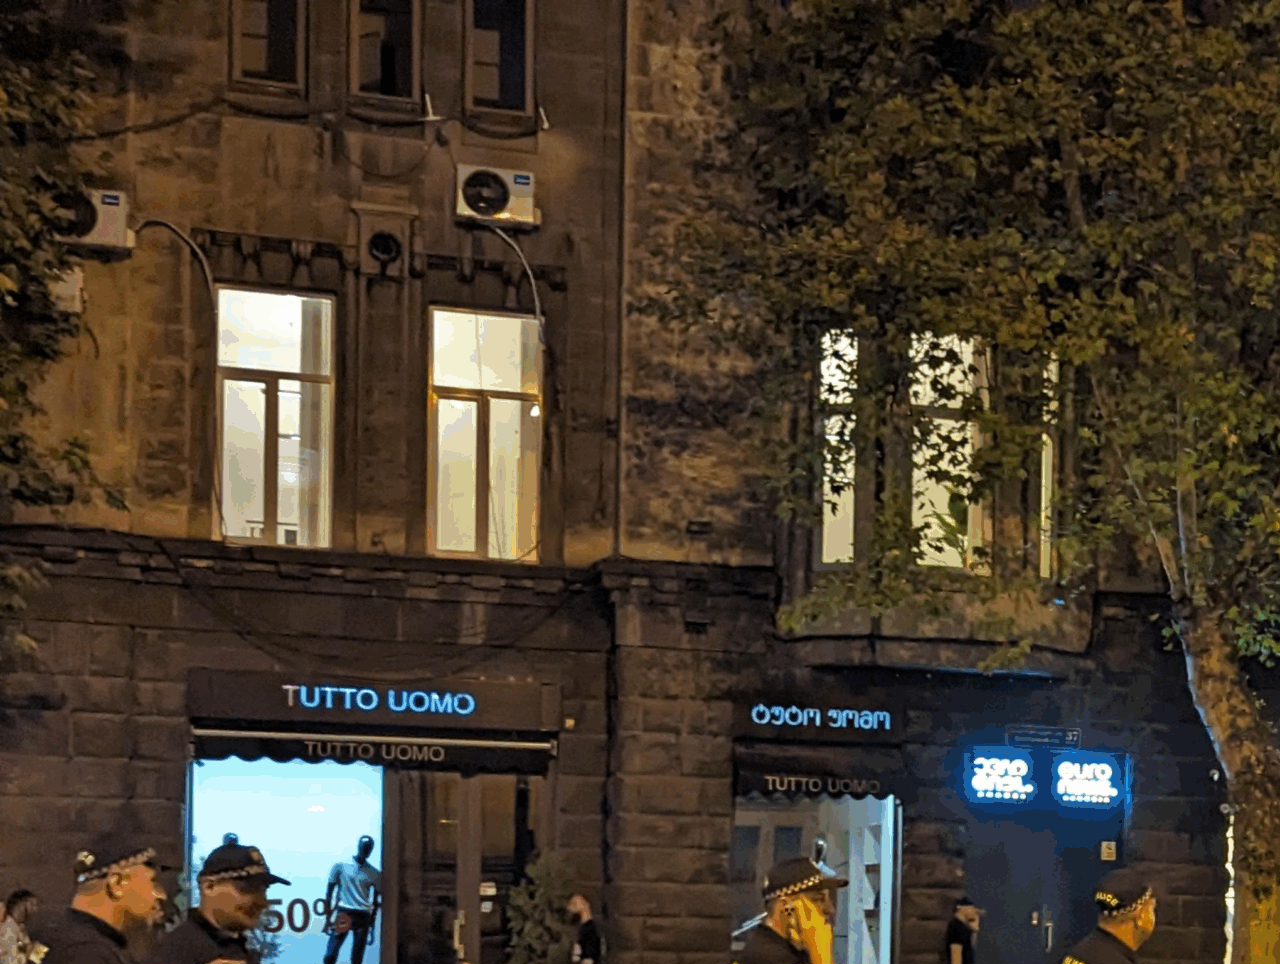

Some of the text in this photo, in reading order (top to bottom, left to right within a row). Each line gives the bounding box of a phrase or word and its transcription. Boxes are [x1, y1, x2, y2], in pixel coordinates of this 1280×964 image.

[282, 684, 476, 715] TUTTO UOMO
[751, 703, 891, 730] ტუტო უომო
[304, 741, 445, 761] TUTTO UOMO
[765, 776, 880, 793] TUTTO UOMO
